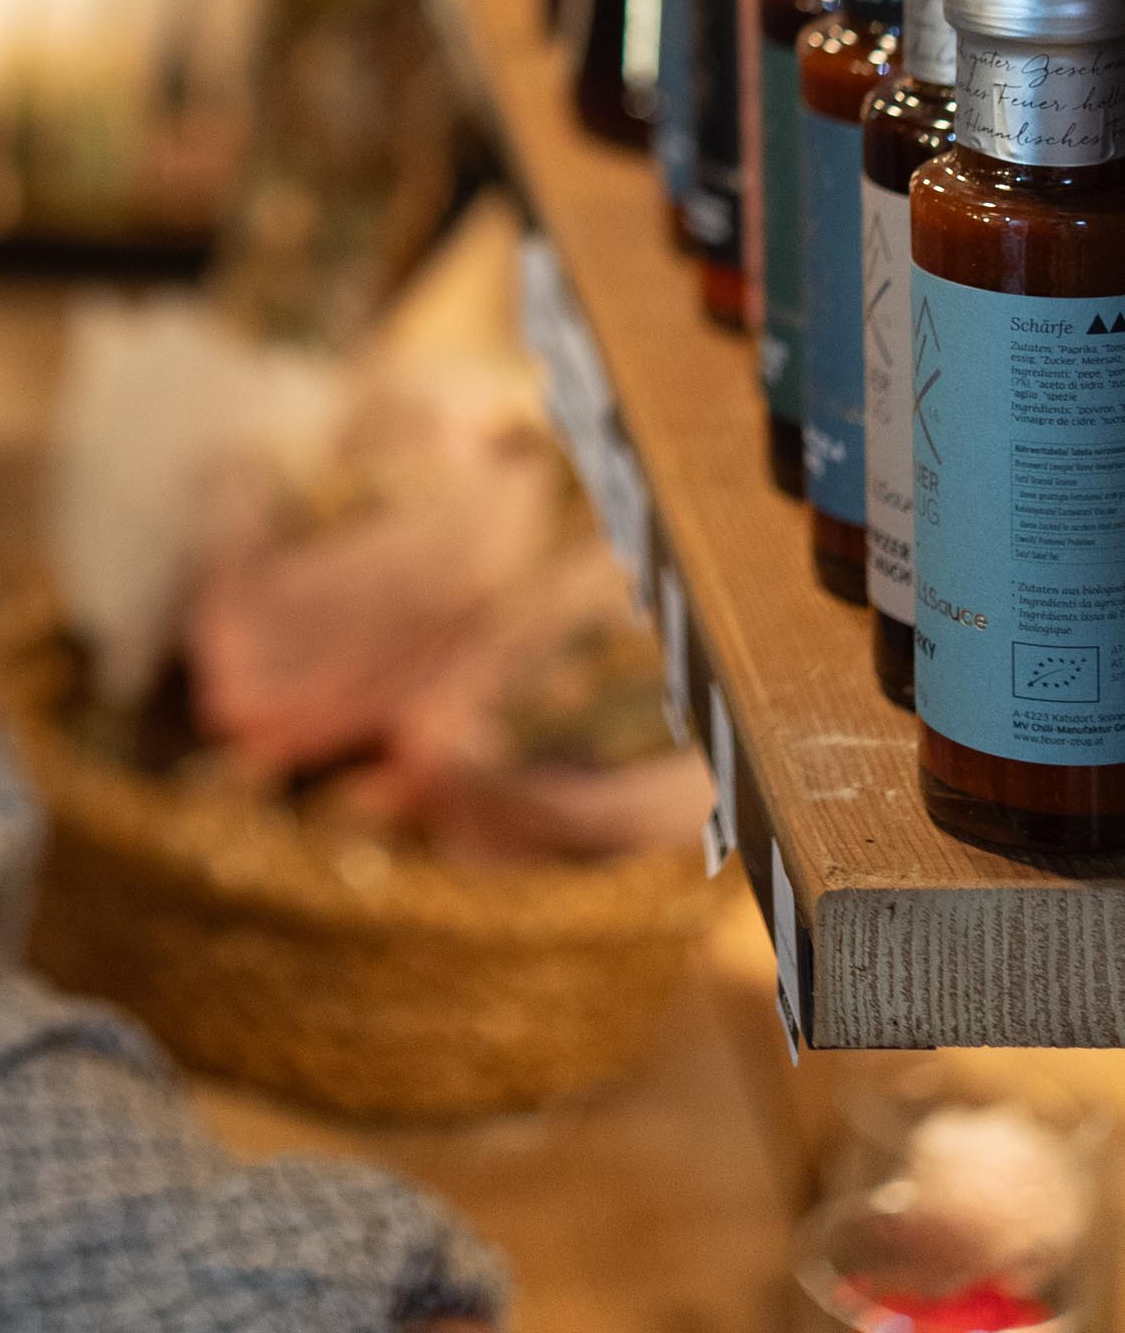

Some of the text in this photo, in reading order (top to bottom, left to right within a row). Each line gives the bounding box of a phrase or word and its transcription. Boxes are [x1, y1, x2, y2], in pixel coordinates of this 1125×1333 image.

[993, 82, 1066, 111] Feuer
[963, 107, 1101, 148] Himmlisches
[1012, 719, 1029, 731] MV
